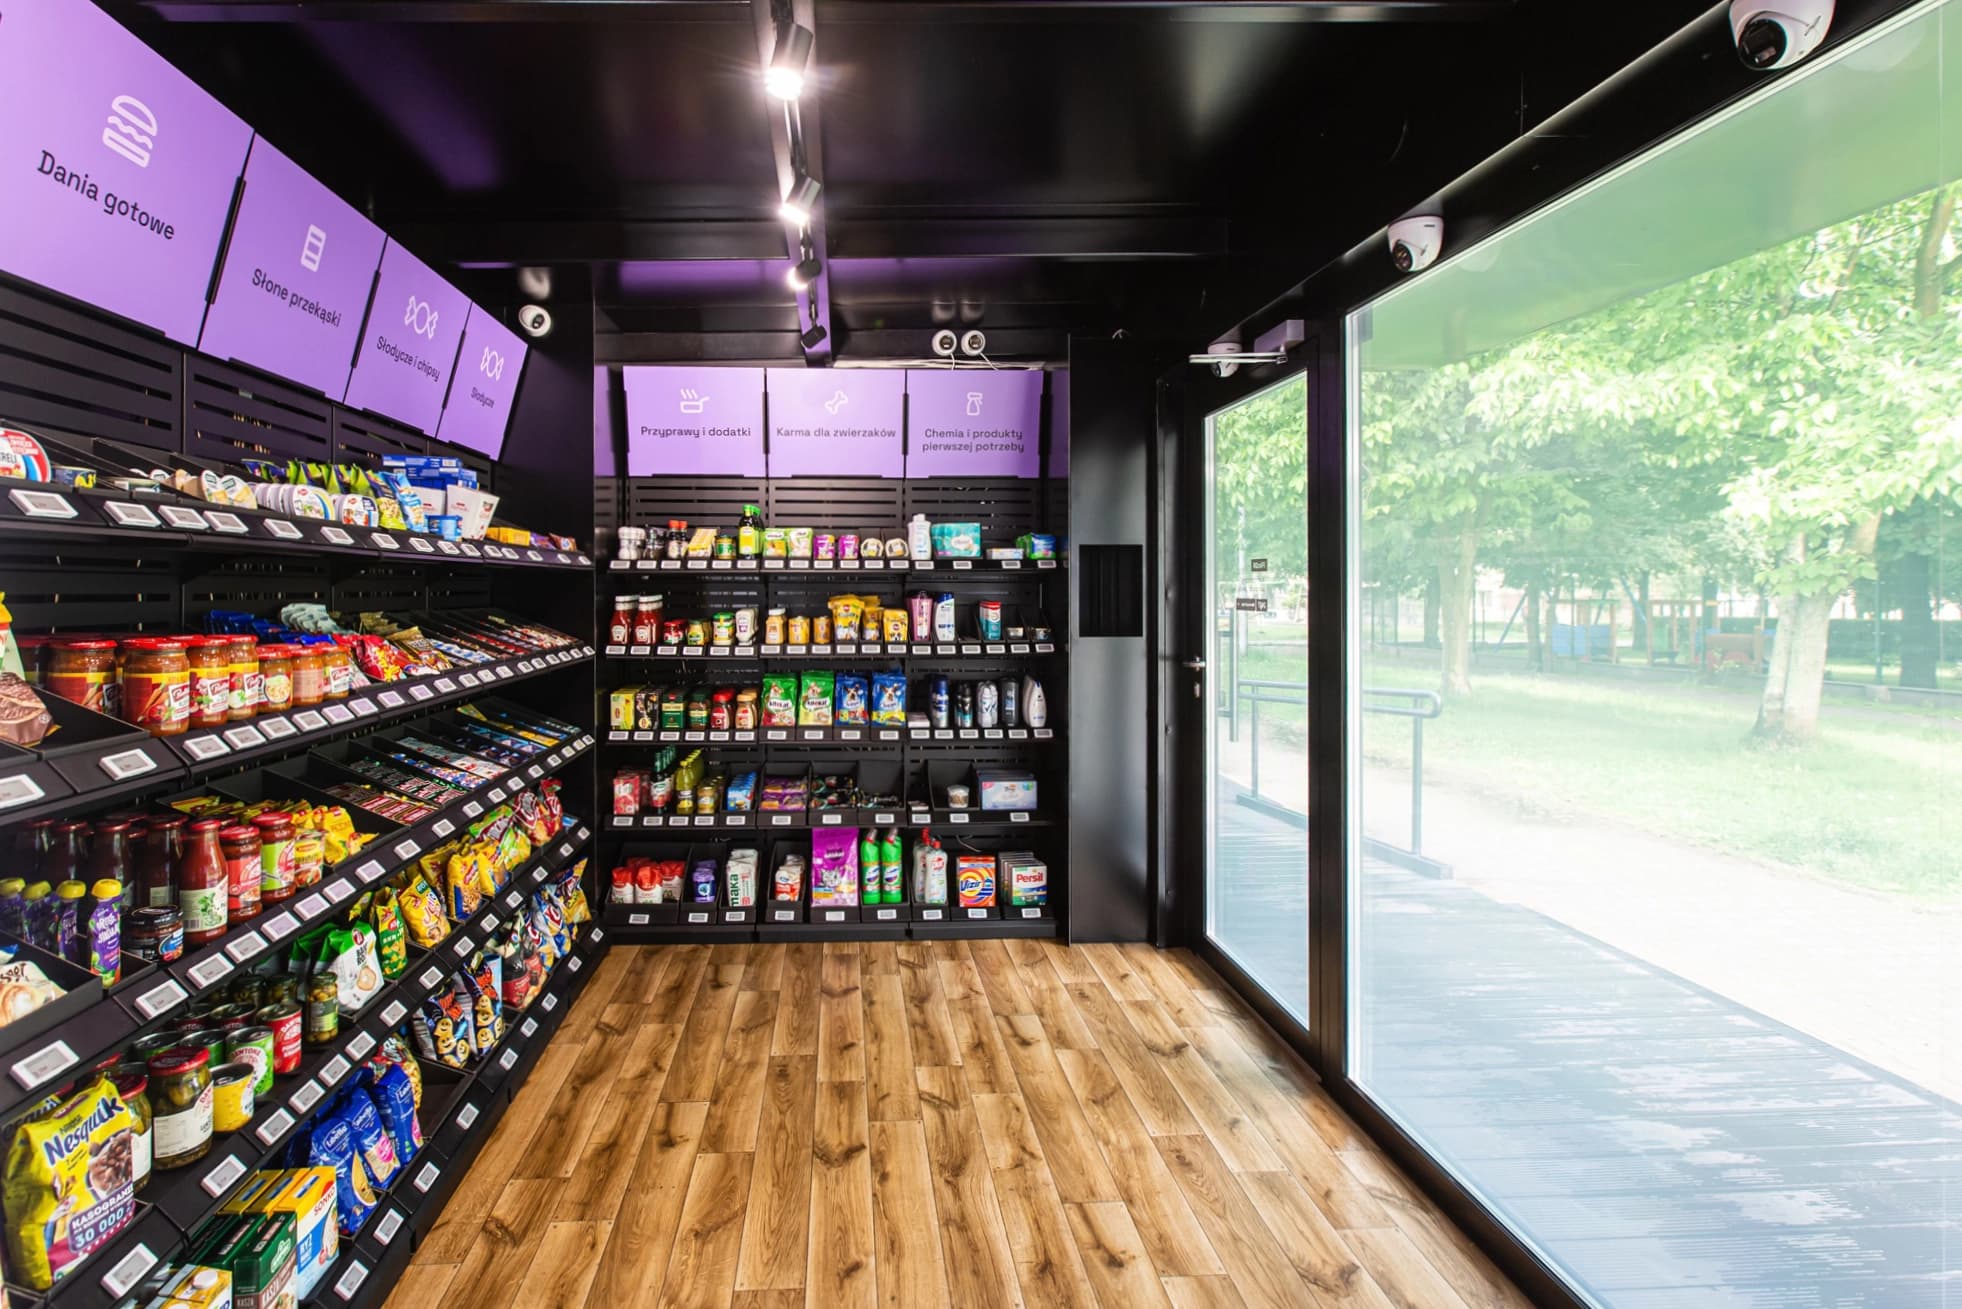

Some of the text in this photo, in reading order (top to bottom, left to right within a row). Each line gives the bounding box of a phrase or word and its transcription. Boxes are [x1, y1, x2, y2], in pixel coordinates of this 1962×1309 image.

[36, 149, 176, 240] Dania gotowe
[251, 267, 342, 329] Słone przekąski
[376, 335, 414, 366] Słodycze
[417, 359, 441, 382] chipsy
[641, 426, 700, 439] Przyprawy
[708, 427, 751, 438] dodatki
[776, 426, 896, 438] Karma dla zwierzaków
[924, 428, 963, 439] Chemia
[972, 428, 1023, 442] produkty
[922, 441, 1024, 453] pierwszej potrzeby
[1015, 872, 1044, 883] Persil
[960, 878, 982, 893] Vizir
[44, 1096, 125, 1165] Nesquik
[75, 1206, 125, 1249] 30 000
